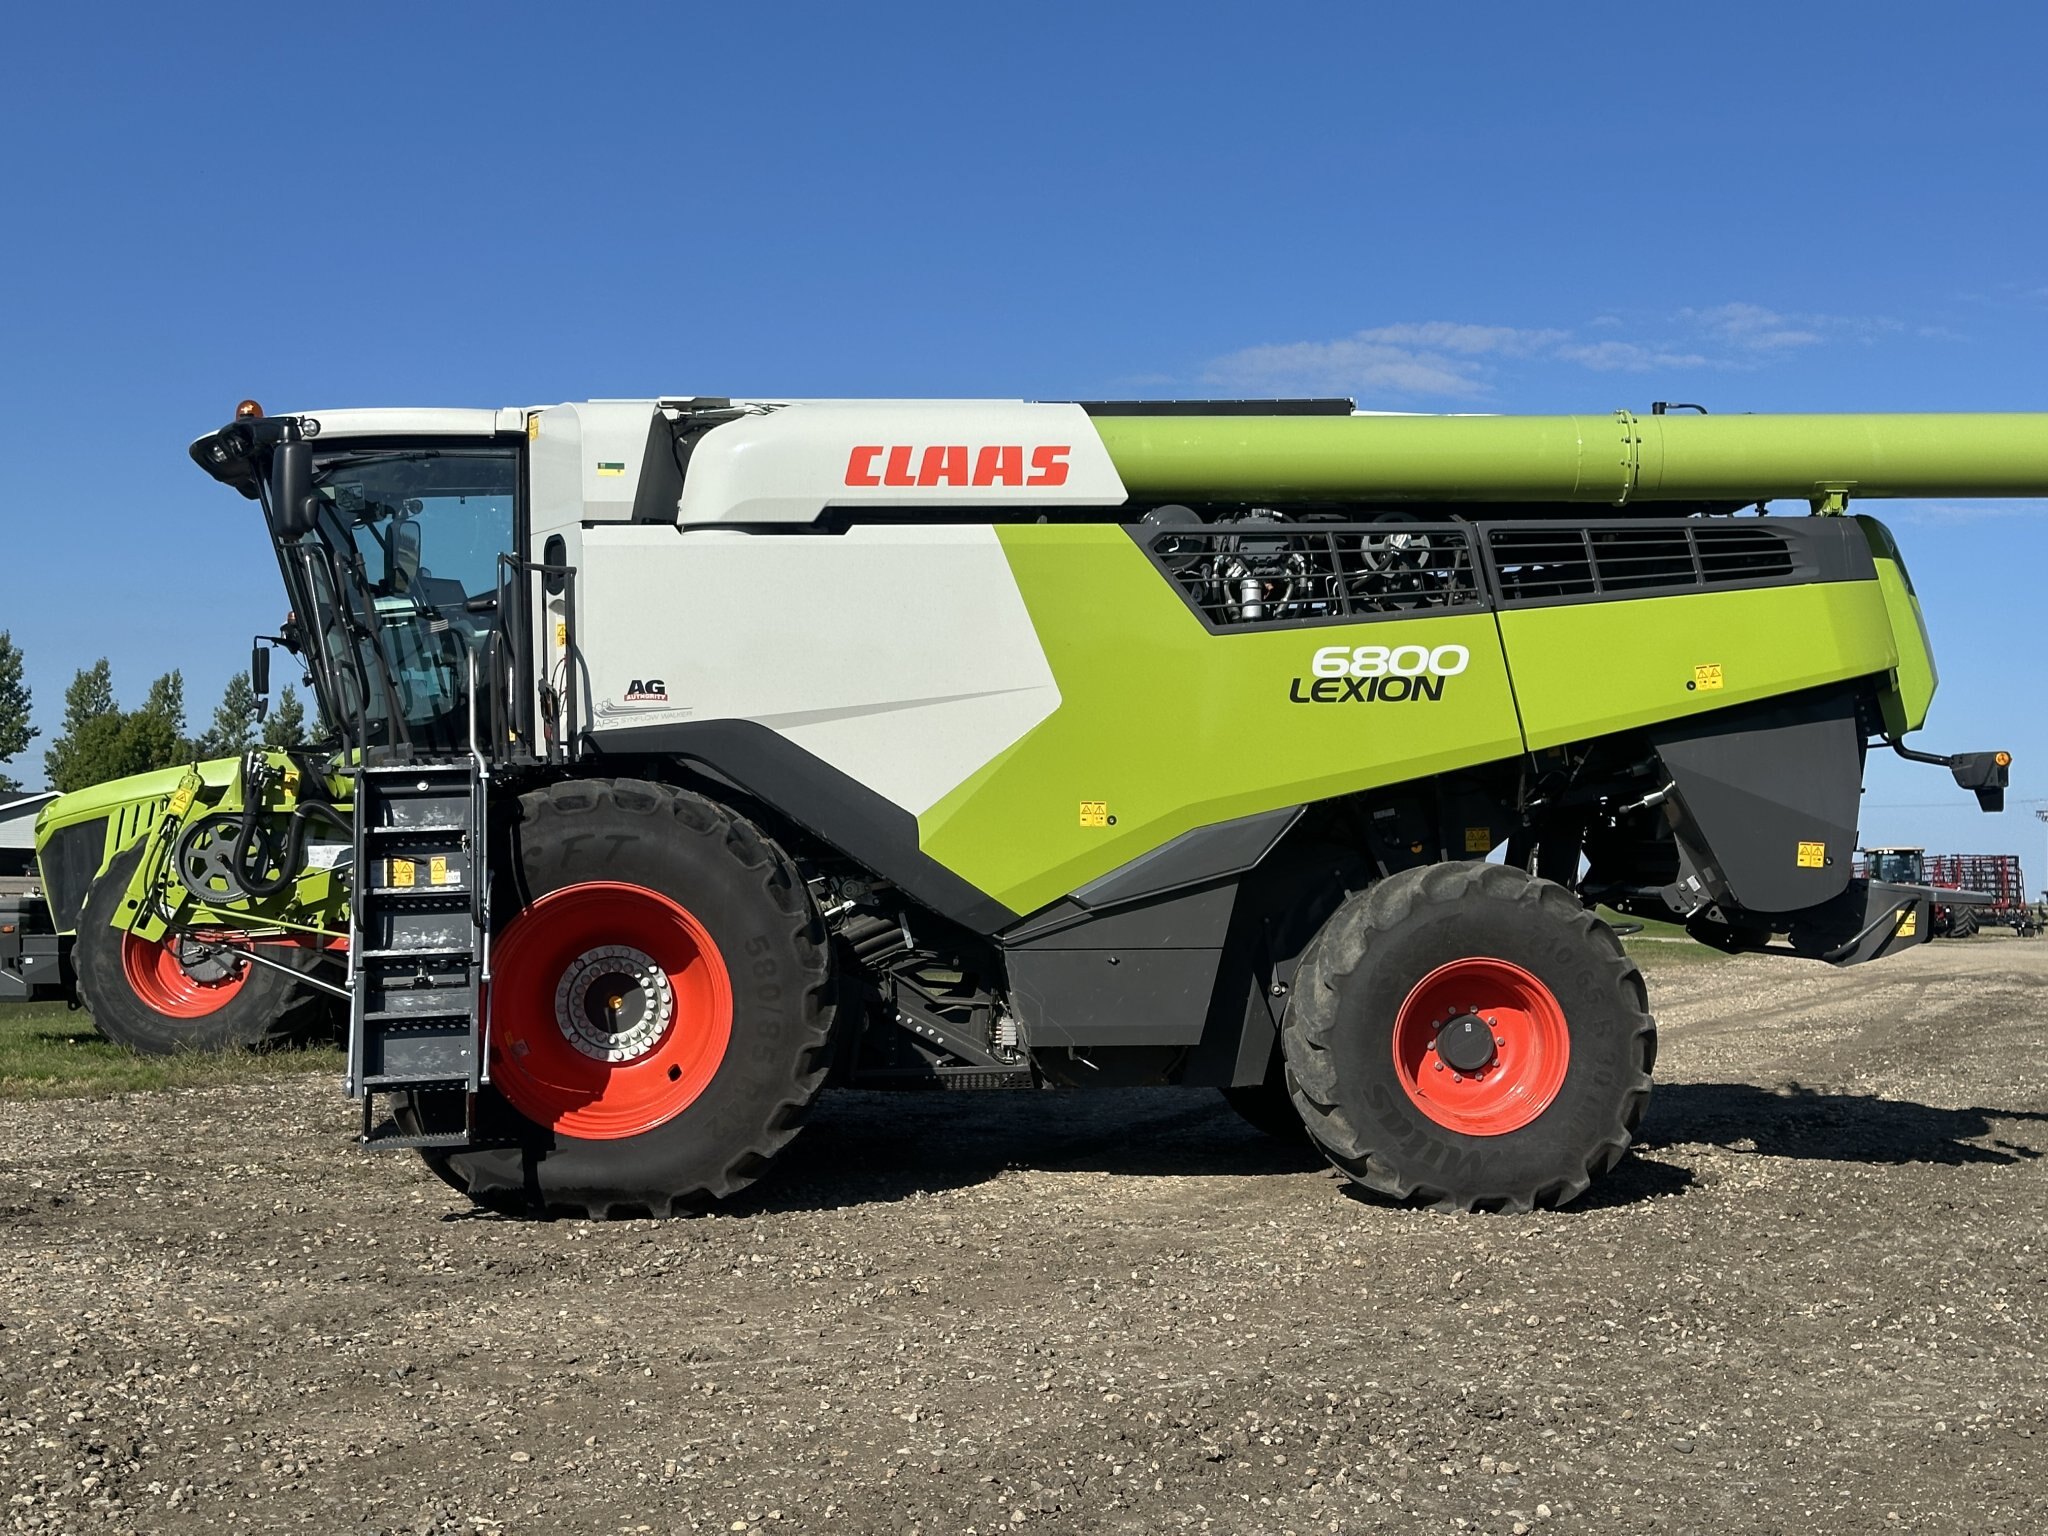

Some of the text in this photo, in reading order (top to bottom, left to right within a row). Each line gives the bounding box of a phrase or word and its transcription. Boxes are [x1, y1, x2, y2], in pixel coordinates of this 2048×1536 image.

[844, 446, 1071, 486] CLAAS
[1312, 644, 1470, 678] 6800
[627, 679, 666, 694] AG
[1289, 675, 1446, 703] LEXION
[594, 710, 693, 728] APS SYNFLOW WALKER
